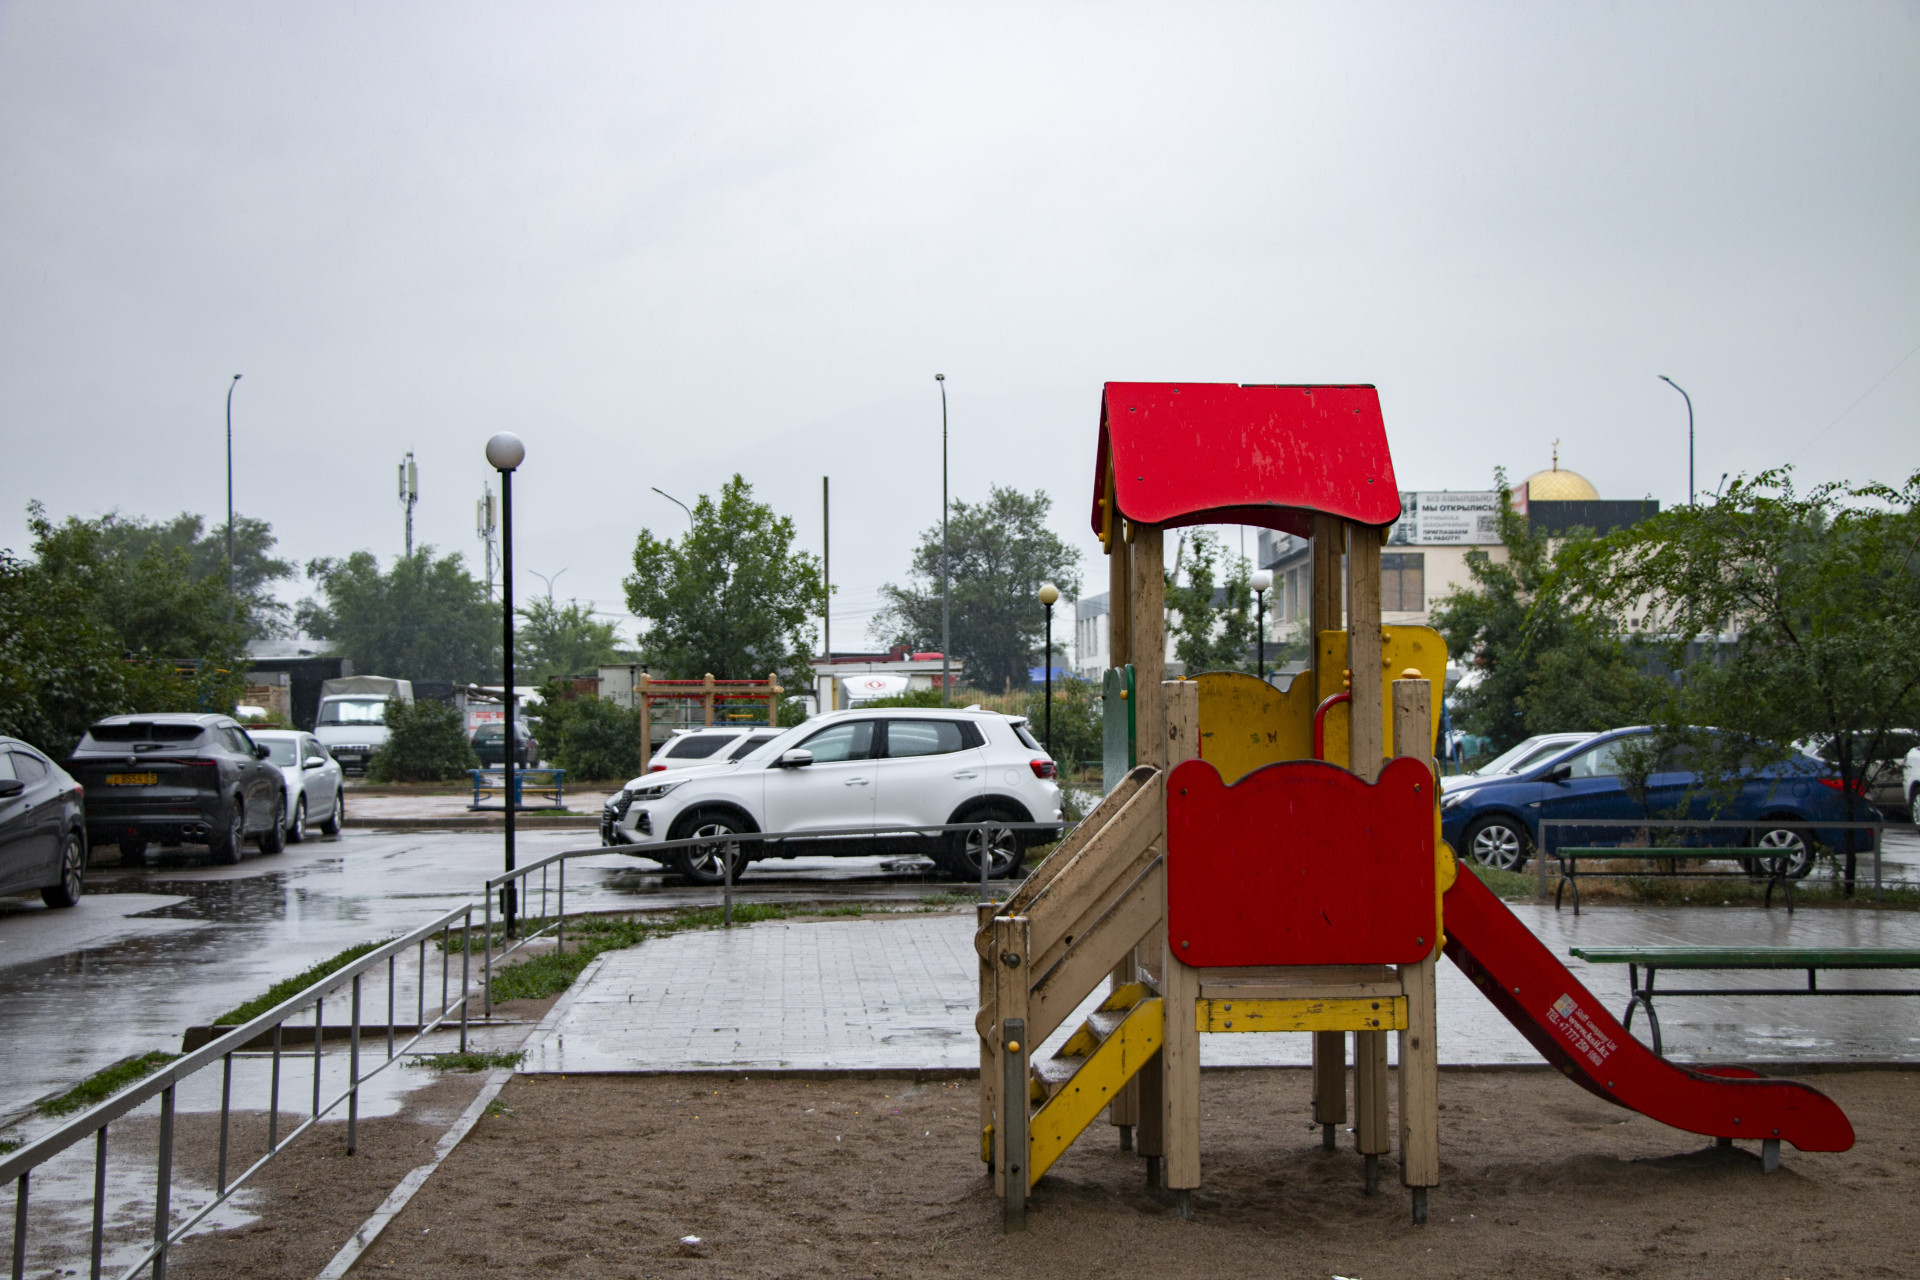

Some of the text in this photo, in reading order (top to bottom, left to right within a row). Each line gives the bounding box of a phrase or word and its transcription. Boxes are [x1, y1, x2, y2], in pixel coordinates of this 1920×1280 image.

[1422, 504, 1437, 512] МЫ
[1565, 1027, 1580, 1042] 777
[1568, 1016, 1610, 1059] www.ksil.kz
